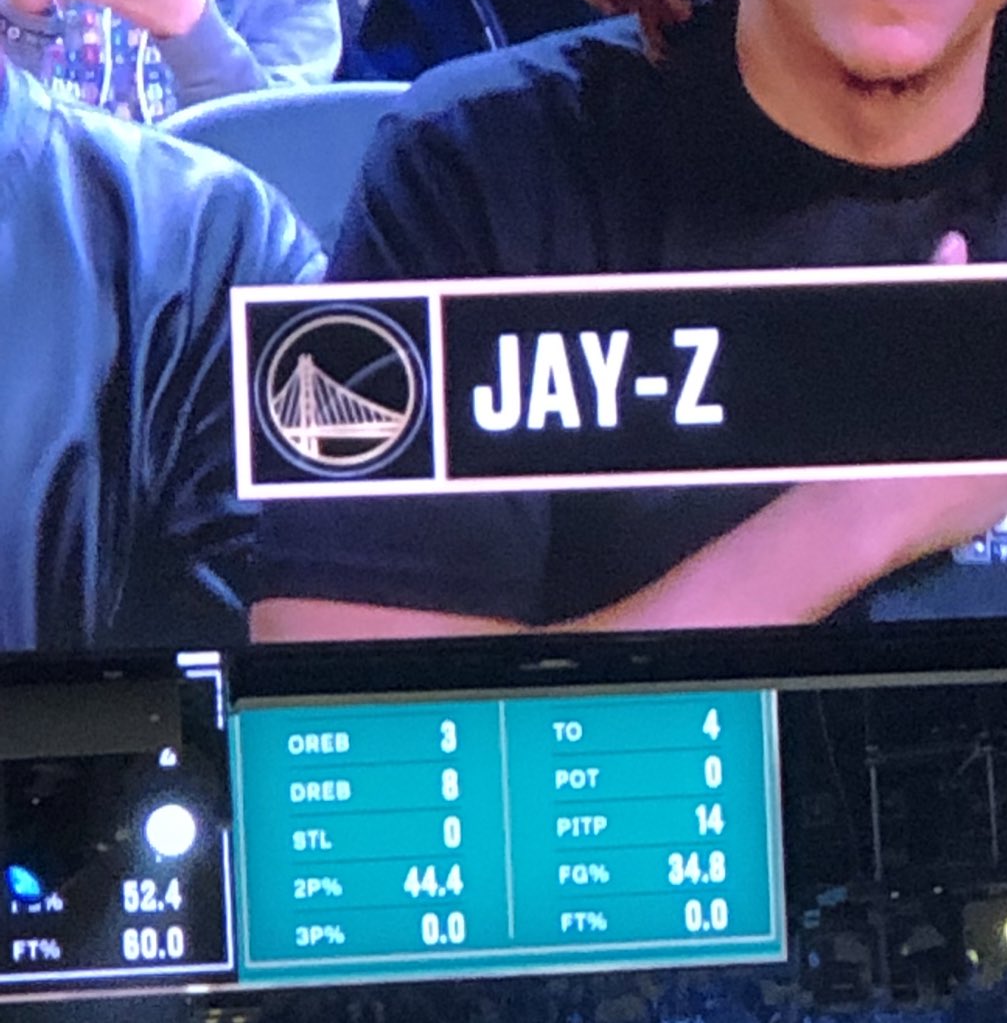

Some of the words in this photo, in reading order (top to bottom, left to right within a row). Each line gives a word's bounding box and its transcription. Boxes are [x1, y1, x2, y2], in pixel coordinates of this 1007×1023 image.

[473, 327, 724, 432] JAY-Z
[288, 732, 350, 755] OREB
[440, 719, 457, 754] 3
[552, 721, 583, 742] TO
[702, 708, 722, 741] 4
[290, 780, 351, 803] DREB
[441, 768, 460, 802] 8
[555, 767, 600, 789] POT
[704, 755, 723, 789] 0
[292, 829, 332, 852] STL
[443, 815, 462, 849] 0
[556, 815, 608, 837] PITP
[695, 802, 726, 836] 14
[293, 877, 343, 899] 2P%
[403, 863, 464, 899] 44.4
[668, 850, 726, 885] 34.8
[123, 878, 182, 913] 52.4
[295, 925, 345, 947] 3P%
[421, 911, 466, 946] 0.0
[560, 911, 608, 933] FT%
[684, 897, 729, 932] 0.0
[12, 938, 61, 963] FT%
[123, 926, 184, 961] 60.0
